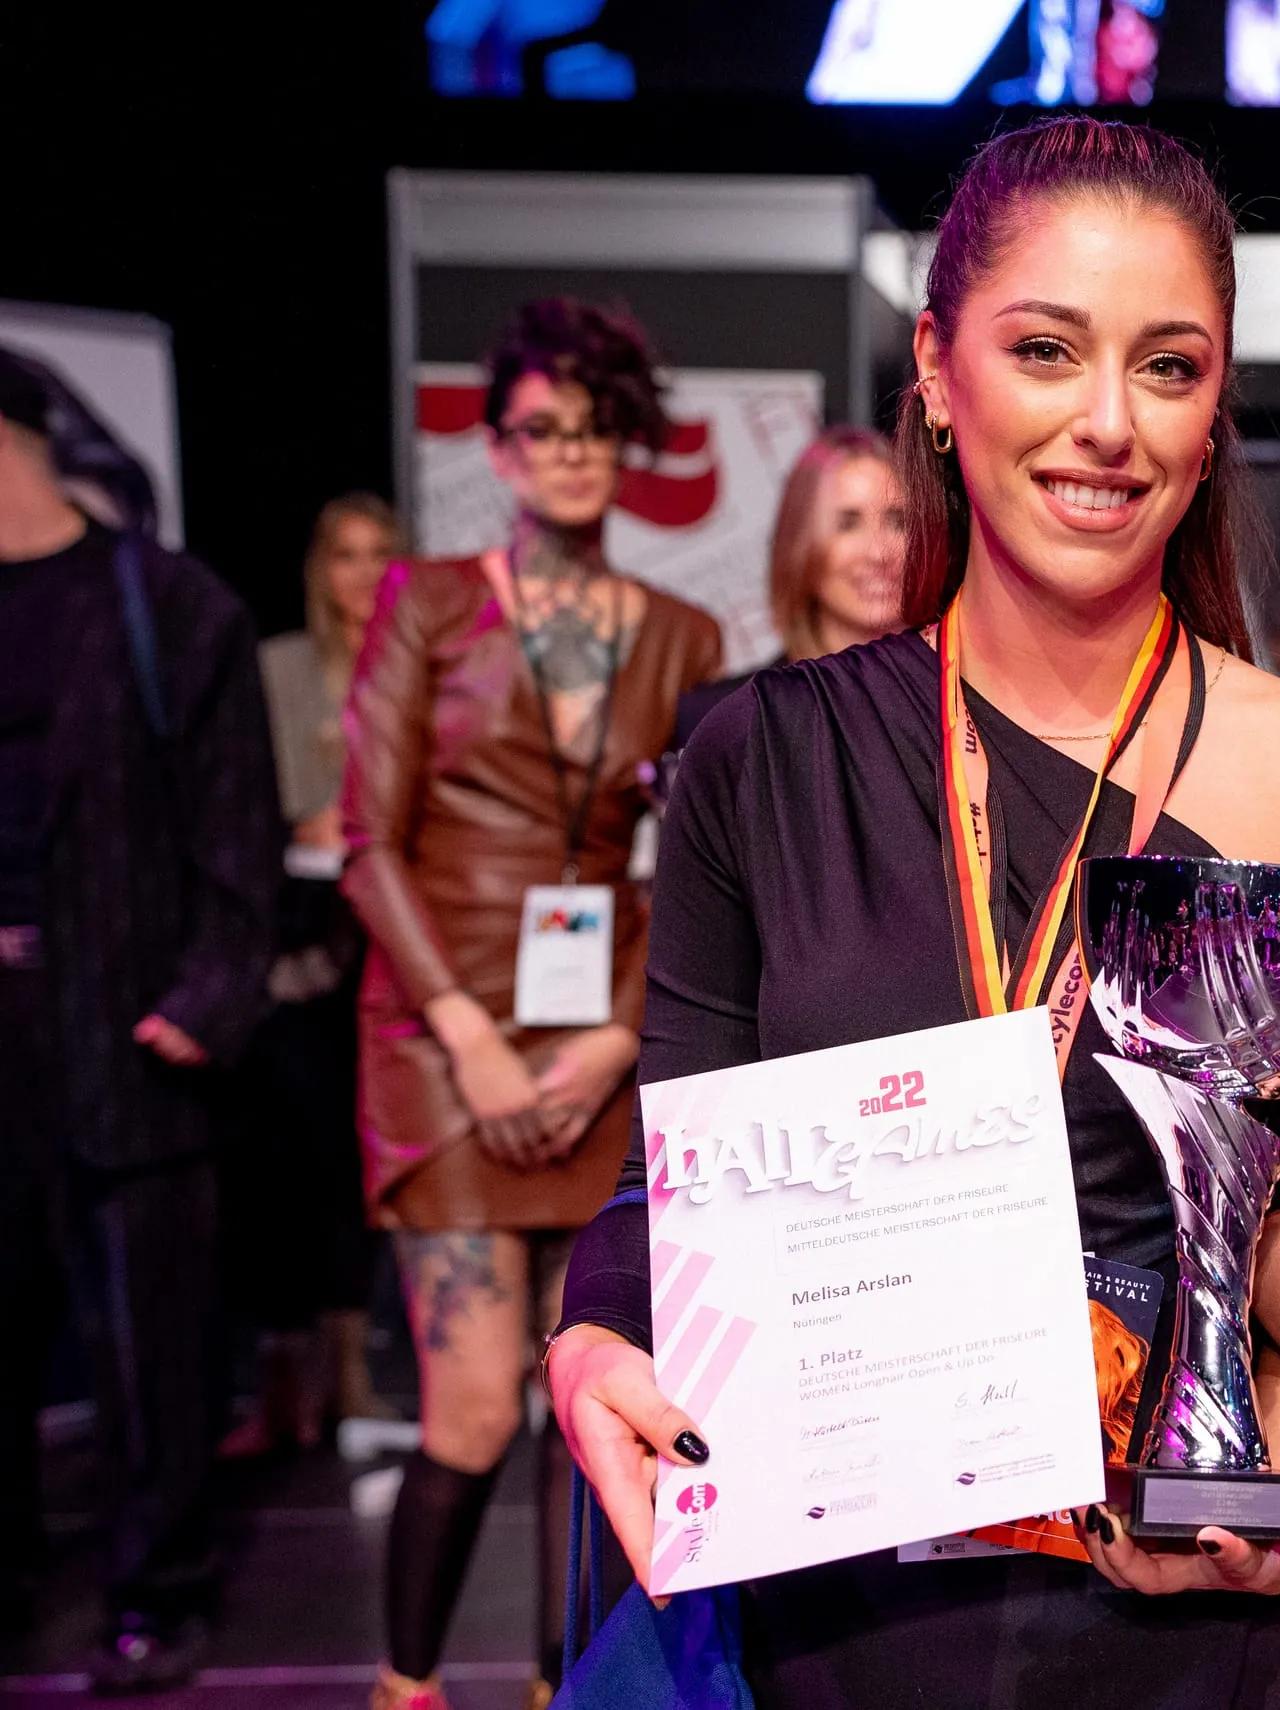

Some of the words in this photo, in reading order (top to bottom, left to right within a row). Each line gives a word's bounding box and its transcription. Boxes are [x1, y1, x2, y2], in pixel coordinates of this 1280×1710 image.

[859, 1070, 927, 1117] 2022
[786, 1213, 842, 1233] DEUTSCHE
[844, 1198, 931, 1223] MEISTERSCHAFT
[933, 1193, 956, 1206] DER
[957, 1183, 1010, 1202] FRISEURE
[787, 1228, 881, 1254] MITTELDEUTSCHE
[883, 1211, 970, 1236] MEISTERSCHAFT
[972, 1205, 995, 1220] DER
[997, 1195, 1049, 1215] FRISEURE
[791, 1284, 852, 1307] Melisa
[856, 1272, 913, 1294] Arslan
[1083, 1279, 1148, 1303] STIVAL
[1086, 1271, 1102, 1280] AIR
[1114, 1277, 1151, 1291] BEAUTY
[798, 1366, 862, 1388] DEUTSCHE
[864, 1344, 963, 1373] MEISTERSCHAFT
[965, 1338, 990, 1355] DER
[992, 1327, 1049, 1349] FRISEURE
[799, 1357, 815, 1372] 1.
[820, 1346, 864, 1368] Platz
[799, 1382, 851, 1402] WOMEN
[853, 1370, 905, 1392] Longhair
[907, 1363, 942, 1382] Open
[944, 1359, 954, 1371] &
[976, 1353, 995, 1364] Do
